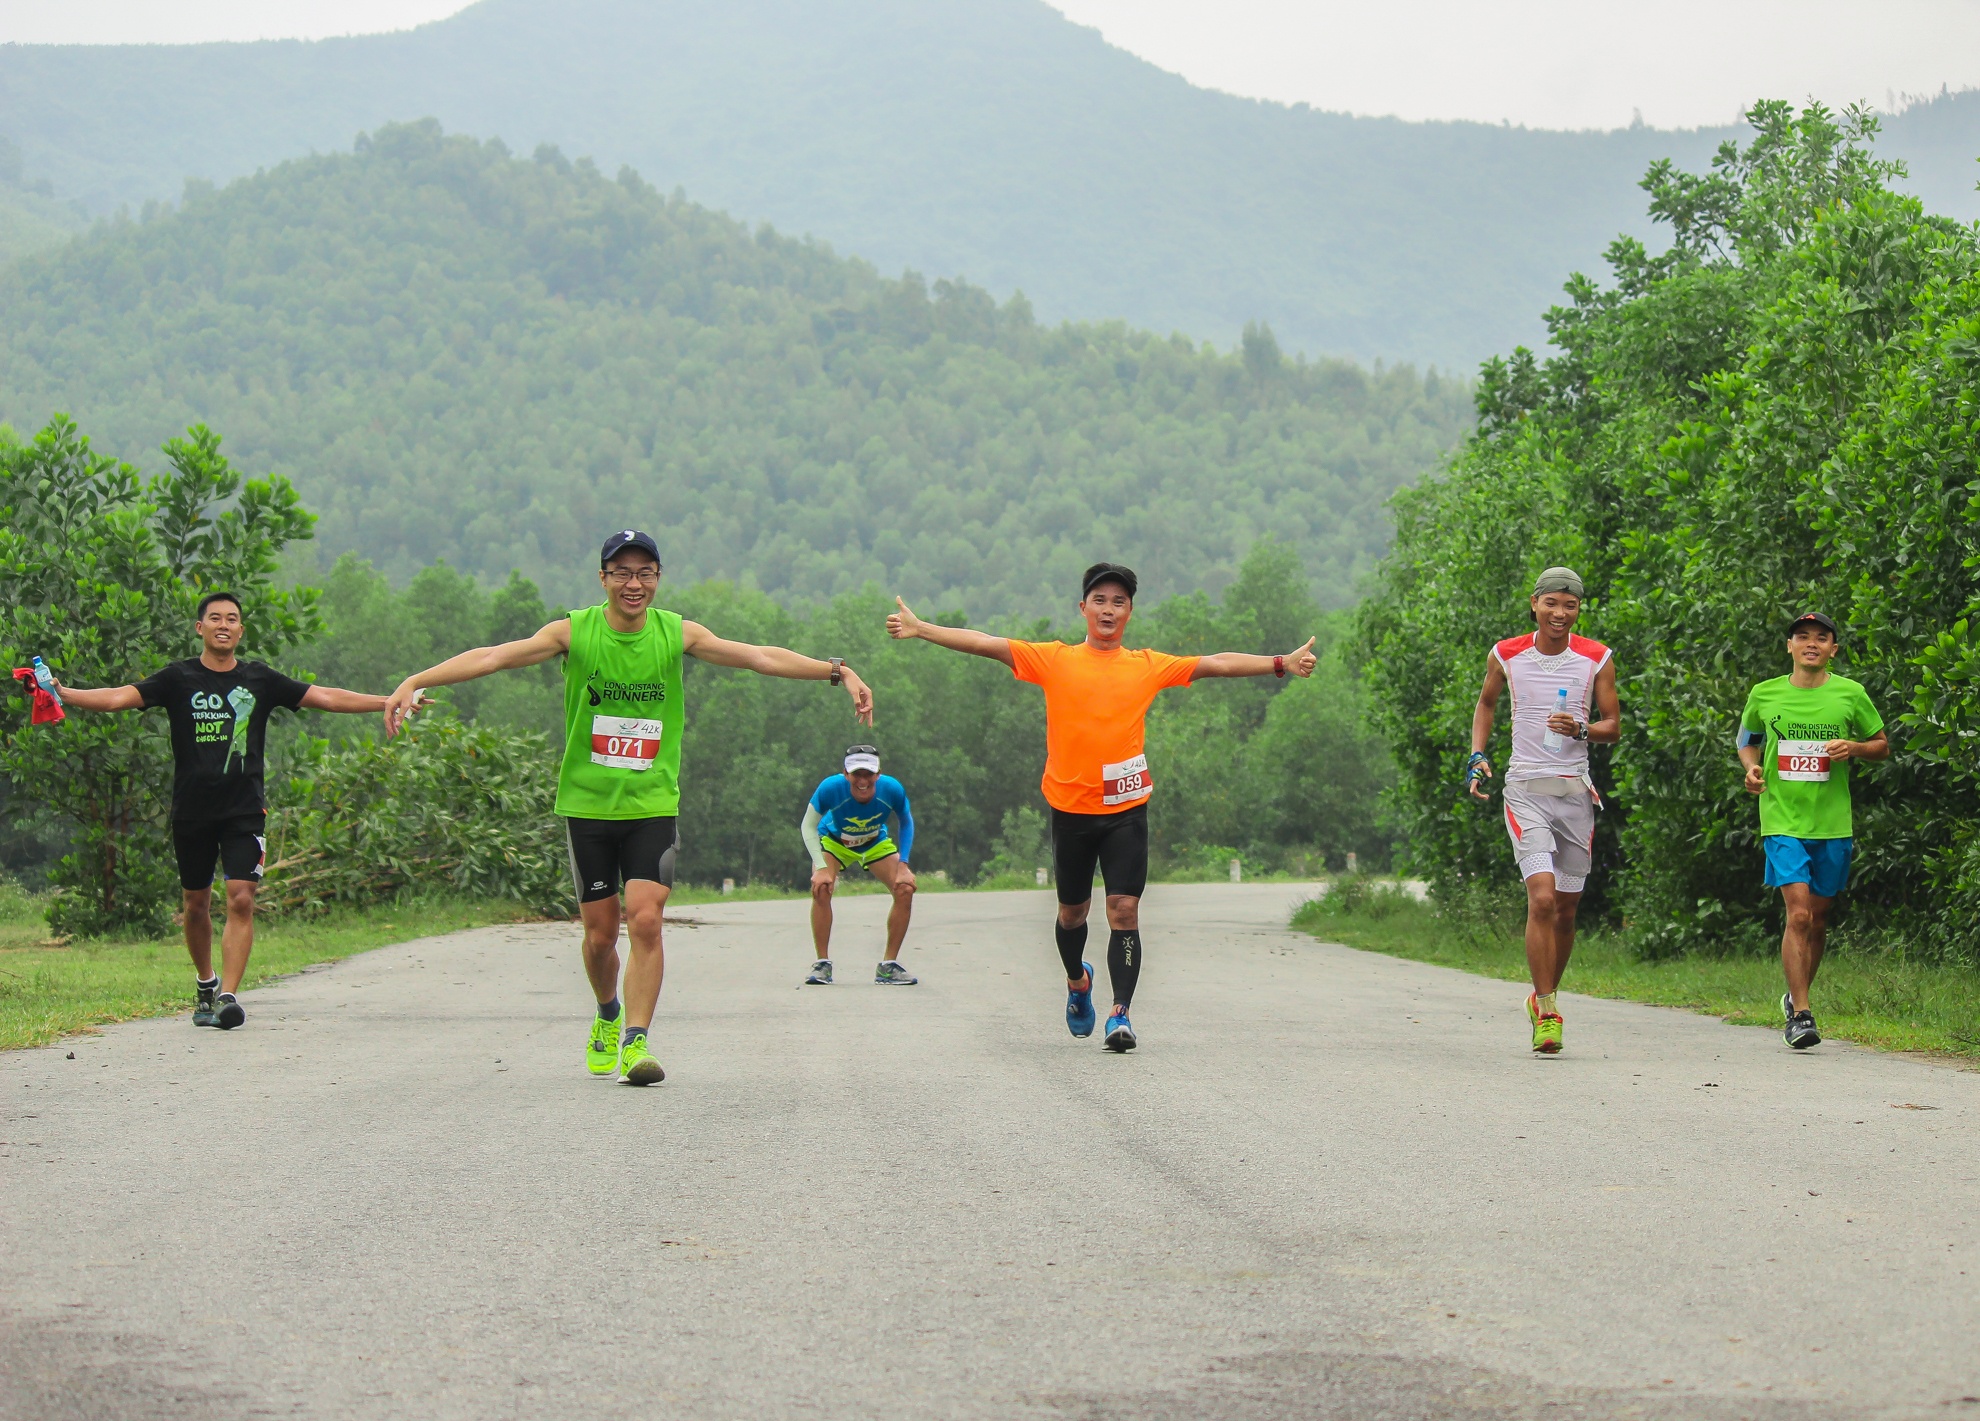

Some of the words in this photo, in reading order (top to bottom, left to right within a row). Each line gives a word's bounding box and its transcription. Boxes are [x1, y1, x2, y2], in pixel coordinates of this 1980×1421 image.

[604, 682, 627, 690] LONG
[191, 691, 223, 710] GO
[603, 689, 665, 702] RUNNERS
[192, 711, 232, 720] TREKKING
[196, 721, 224, 734] NOT
[641, 723, 660, 734] 42K
[1809, 723, 1840, 732] DISTANCE
[196, 734, 228, 743] CHECK-IN
[1788, 730, 1840, 740] RUNNERS
[607, 737, 643, 757] 071
[1814, 744, 1827, 754] 42
[1790, 756, 1819, 771] 028
[1117, 773, 1142, 794] 059
